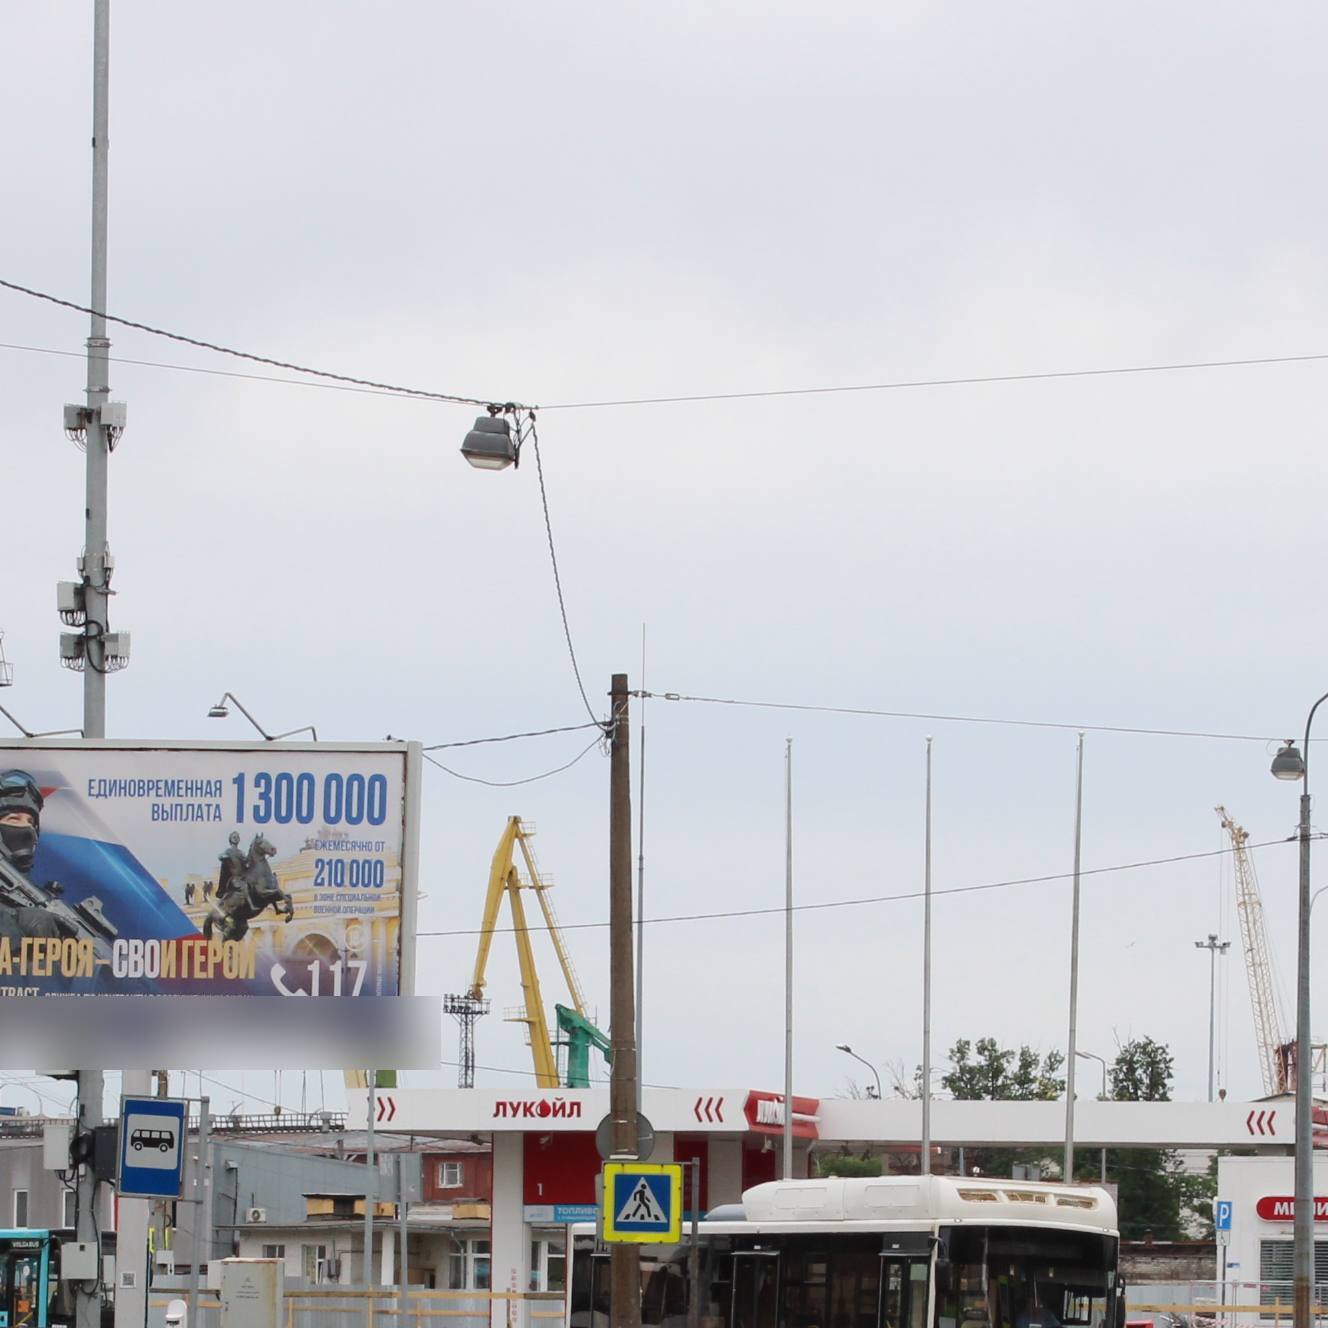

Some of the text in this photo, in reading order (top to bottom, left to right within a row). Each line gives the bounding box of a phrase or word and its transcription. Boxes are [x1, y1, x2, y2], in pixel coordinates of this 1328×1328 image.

[88, 778, 222, 799] ЕДИНОВРЕМЕННАЯ
[232, 772, 388, 826] 1 300 000
[151, 803, 222, 822] ВЫПЛАТА
[314, 839, 385, 853] ЕЖЕМЕСЯЧНО ОТ
[313, 858, 384, 889] 210 000
[112, 939, 176, 980] СВОИ
[181, 939, 257, 980] ГЕРОИ
[493, 1096, 582, 1118] ЛУКОЙЛ
